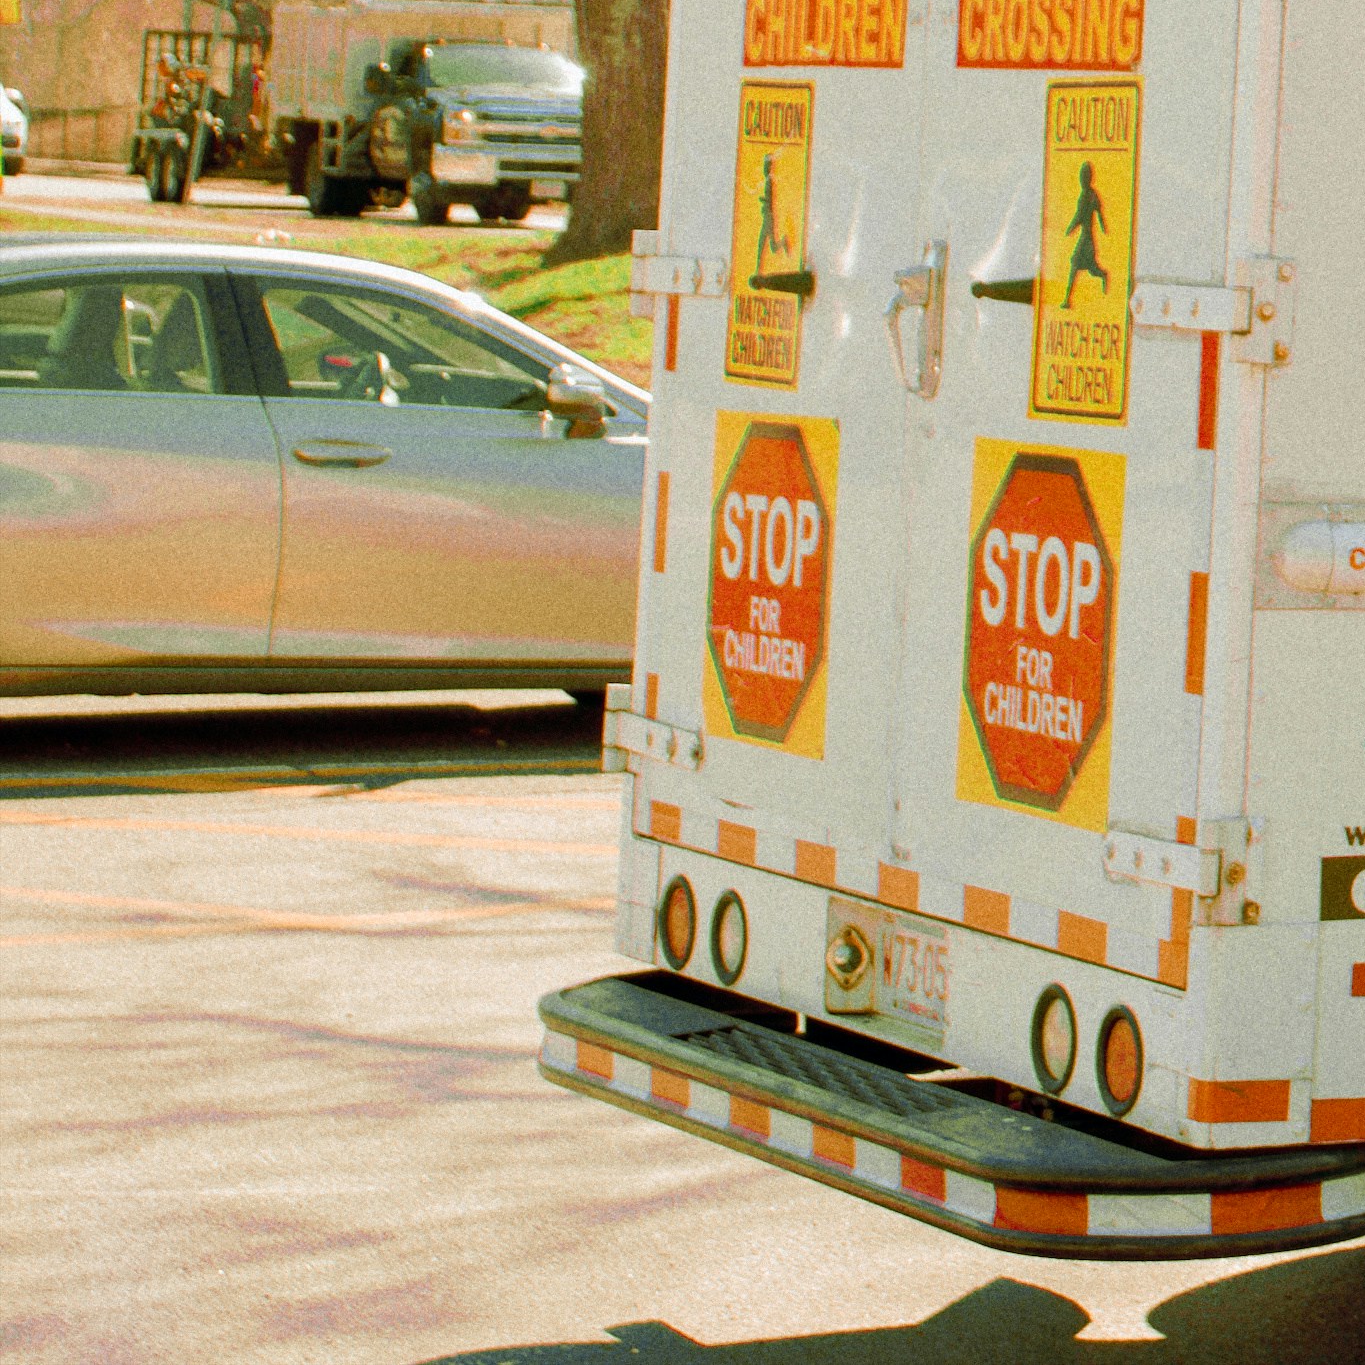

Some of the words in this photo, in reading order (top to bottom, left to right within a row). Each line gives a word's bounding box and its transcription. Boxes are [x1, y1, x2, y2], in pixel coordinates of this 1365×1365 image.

[744, 99, 803, 140] CAUTION
[1055, 95, 1130, 144] CAUTION
[731, 330, 794, 371] CHILDREN
[1043, 319, 1089, 358] WATCH
[1091, 321, 1120, 362] FOR
[1046, 362, 1115, 405] CHILDREN
[720, 491, 821, 588] STOP
[979, 527, 1101, 639] STOP
[750, 595, 782, 635] FOR
[724, 628, 805, 682] CHILDREN
[1016, 645, 1054, 689] FOR
[983, 682, 1083, 743] CHILDREN
